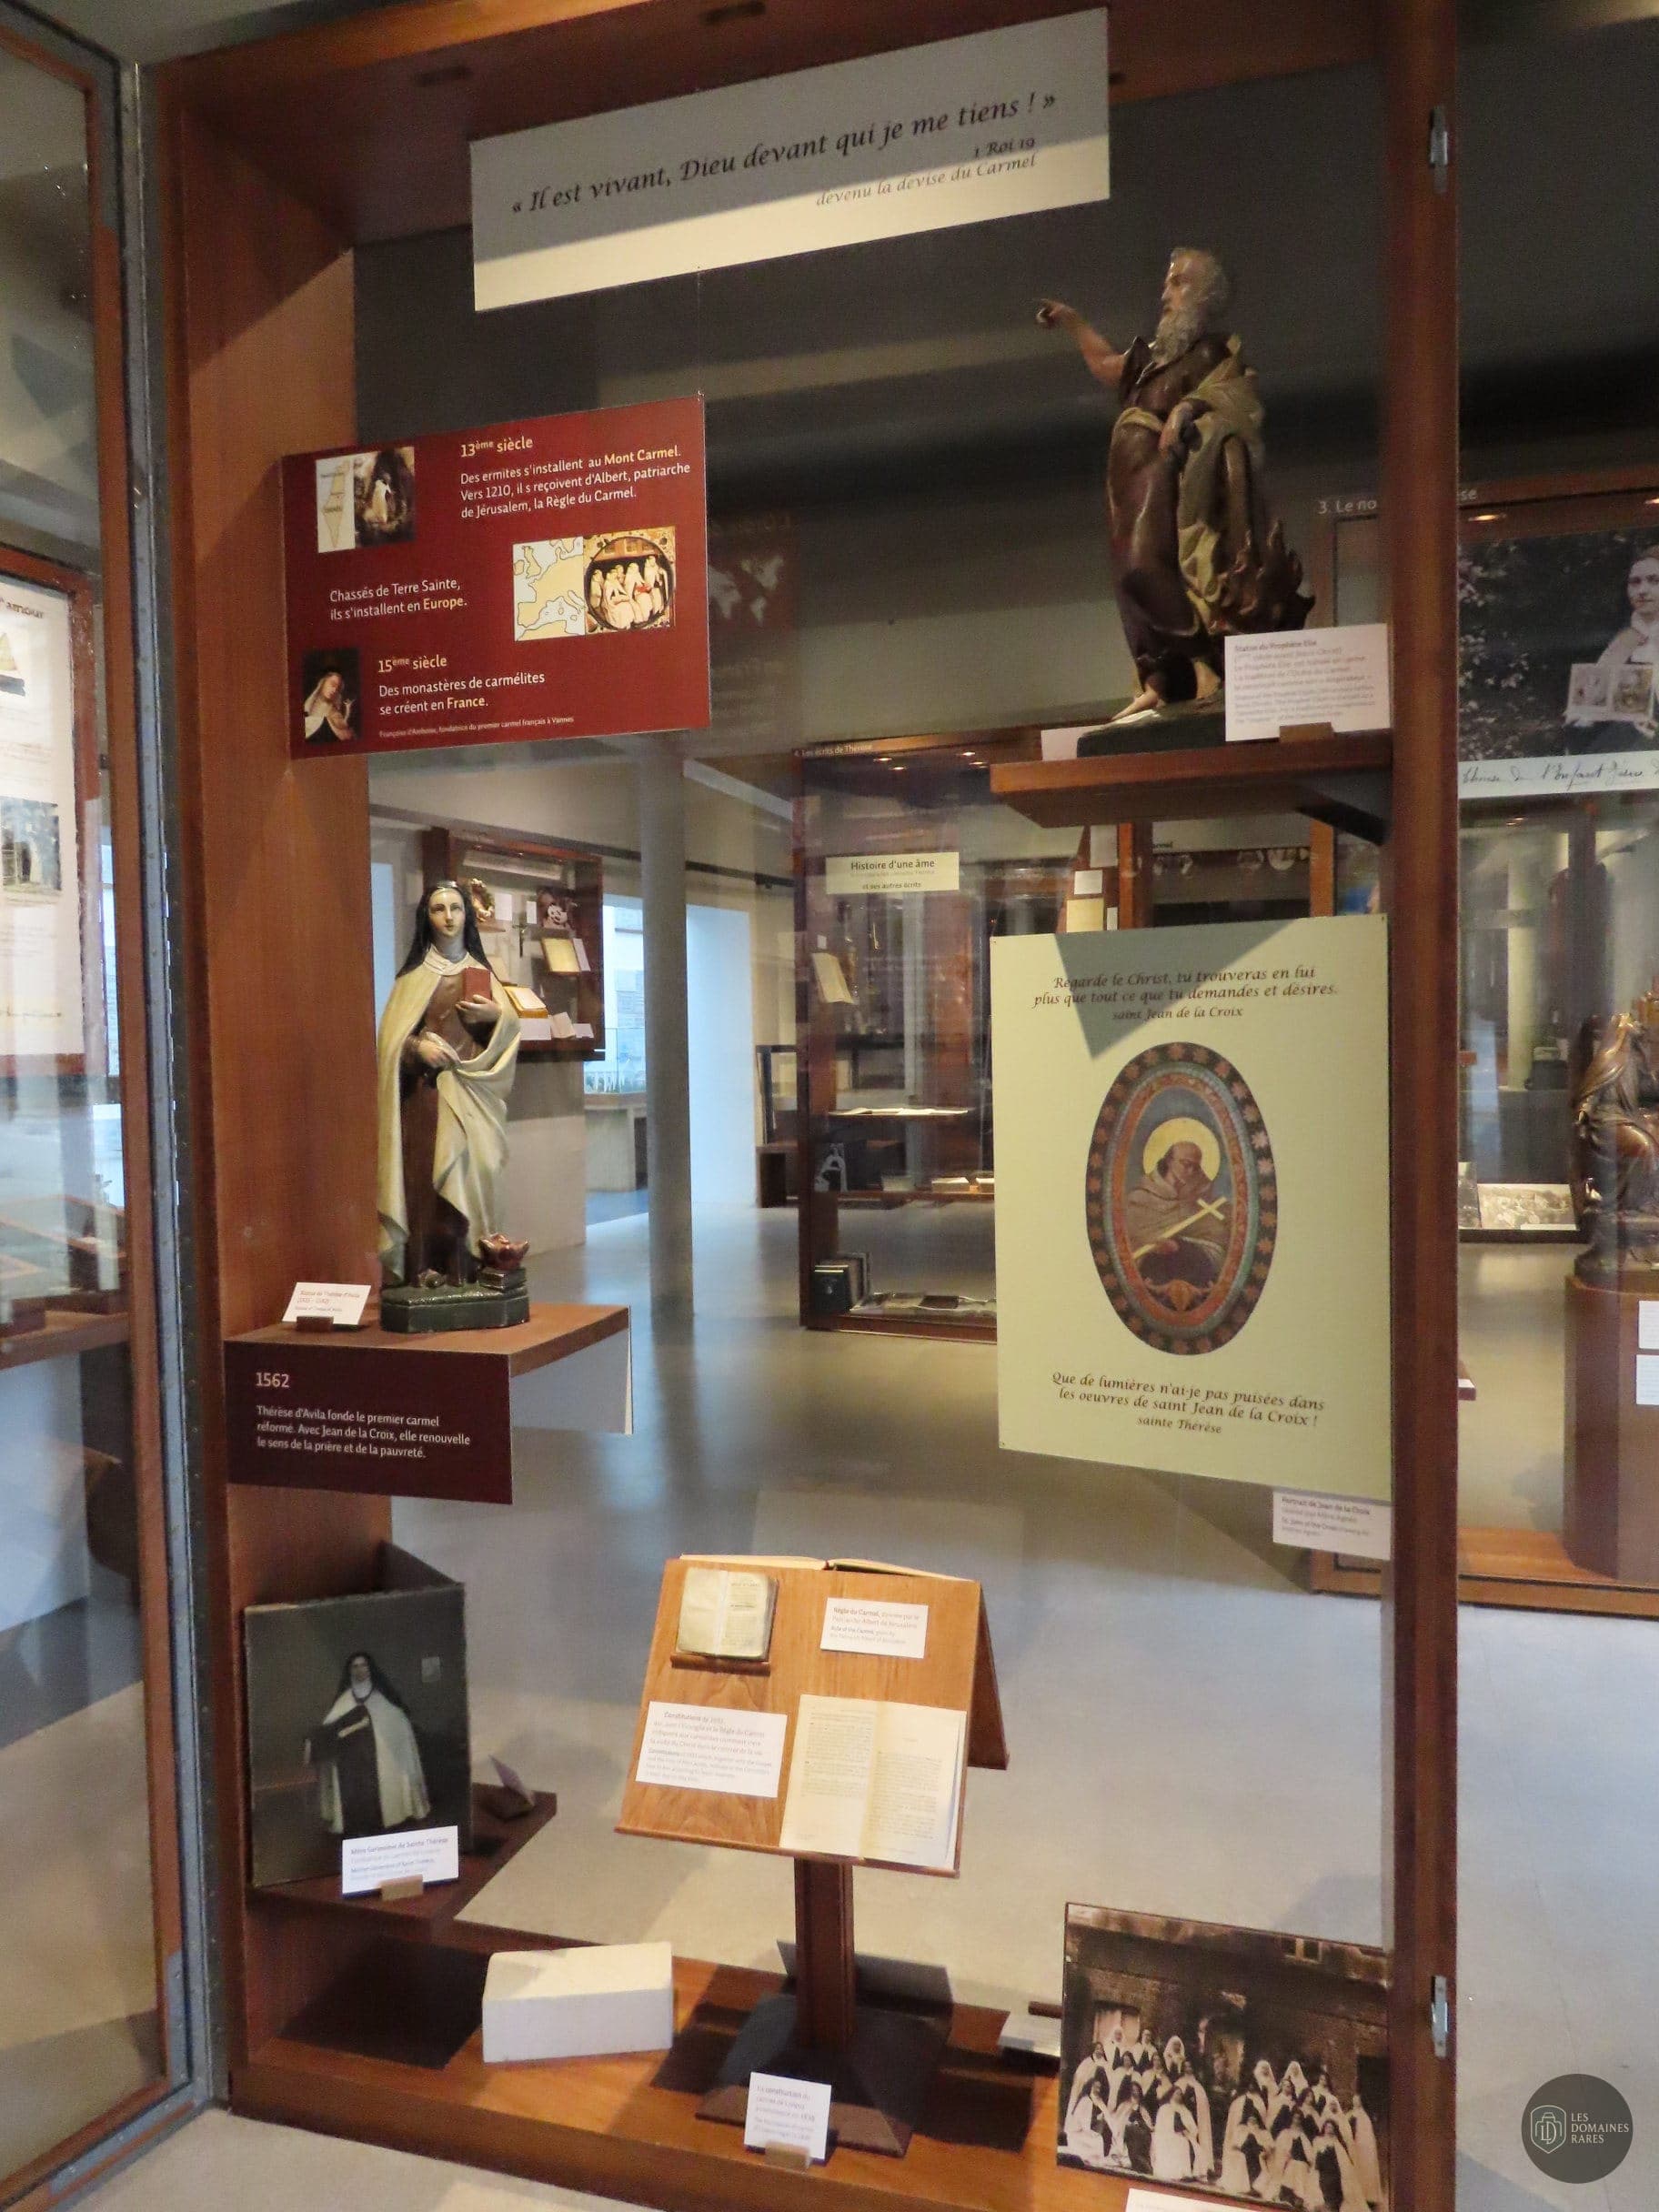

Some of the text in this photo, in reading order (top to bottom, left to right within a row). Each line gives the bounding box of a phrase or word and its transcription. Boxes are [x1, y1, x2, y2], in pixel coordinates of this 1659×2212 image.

[529, 186, 551, 211] Il
[553, 185, 580, 206] est
[590, 168, 671, 198] vivant,
[680, 156, 735, 182] Dieu
[743, 136, 826, 170] devant
[836, 122, 874, 156] qui
[878, 122, 902, 150] je
[912, 114, 949, 136] me
[959, 99, 1019, 126] tiens
[987, 140, 1014, 155] Roi
[816, 154, 1036, 206] devenu la devise du Carmel
[461, 436, 534, 457] 13ème siècle
[460, 445, 681, 485] Des ermites s'installent au Mont Carmel.
[461, 489, 483, 501] Vers
[486, 485, 514, 498] 1210,
[534, 477, 582, 493] reçoivent
[585, 471, 631, 485] d'Albert,
[634, 463, 691, 482] patriarche
[461, 487, 637, 519] de Jérusalem, la Règle du Carmel.
[330, 578, 460, 602] Chassés de Terre Sainte,
[330, 597, 468, 620] ils s'installent en Europe.
[378, 654, 447, 673] 15ème siècle
[379, 672, 545, 697] Des monastères de carmélites
[379, 697, 488, 715] se créent en France.
[501, 719, 521, 728] carmel
[850, 859, 935, 871] Histoire d'une âme
[1054, 973, 1108, 991] Regarde
[1112, 972, 1124, 986] le
[1127, 973, 1171, 987] Christ,
[1177, 972, 1191, 983] tu
[1197, 970, 1267, 983] trouveras
[1272, 968, 1289, 980] en
[1031, 981, 1338, 1009] plus que tout ce que tu demandes et désires.
[1112, 1005, 1244, 1021] saint Jean de la Croix
[256, 1372, 290, 1388] 1562
[1052, 1372, 1325, 1410] Que de lumières n'ai-je pas puisées dans
[256, 1404, 439, 1426] Thérèse d'Avila fonde le premier carmel
[1059, 1387, 1074, 1400] les
[1079, 1392, 1129, 1405] oeuvres
[1133, 1395, 1149, 1408] de
[1152, 1400, 1186, 1412] saint
[1191, 1402, 1223, 1416] Jean
[1228, 1404, 1245, 1418] de
[1250, 1407, 1263, 1421] la
[1268, 1410, 1308, 1425] Croix
[256, 1421, 470, 1445] réformé. Avec Jean de la Croix, elle renouvelle
[1137, 1416, 1222, 1433] sainte Thérèse
[256, 1436, 427, 1458] le sens de la prière et de la pauvreté.
